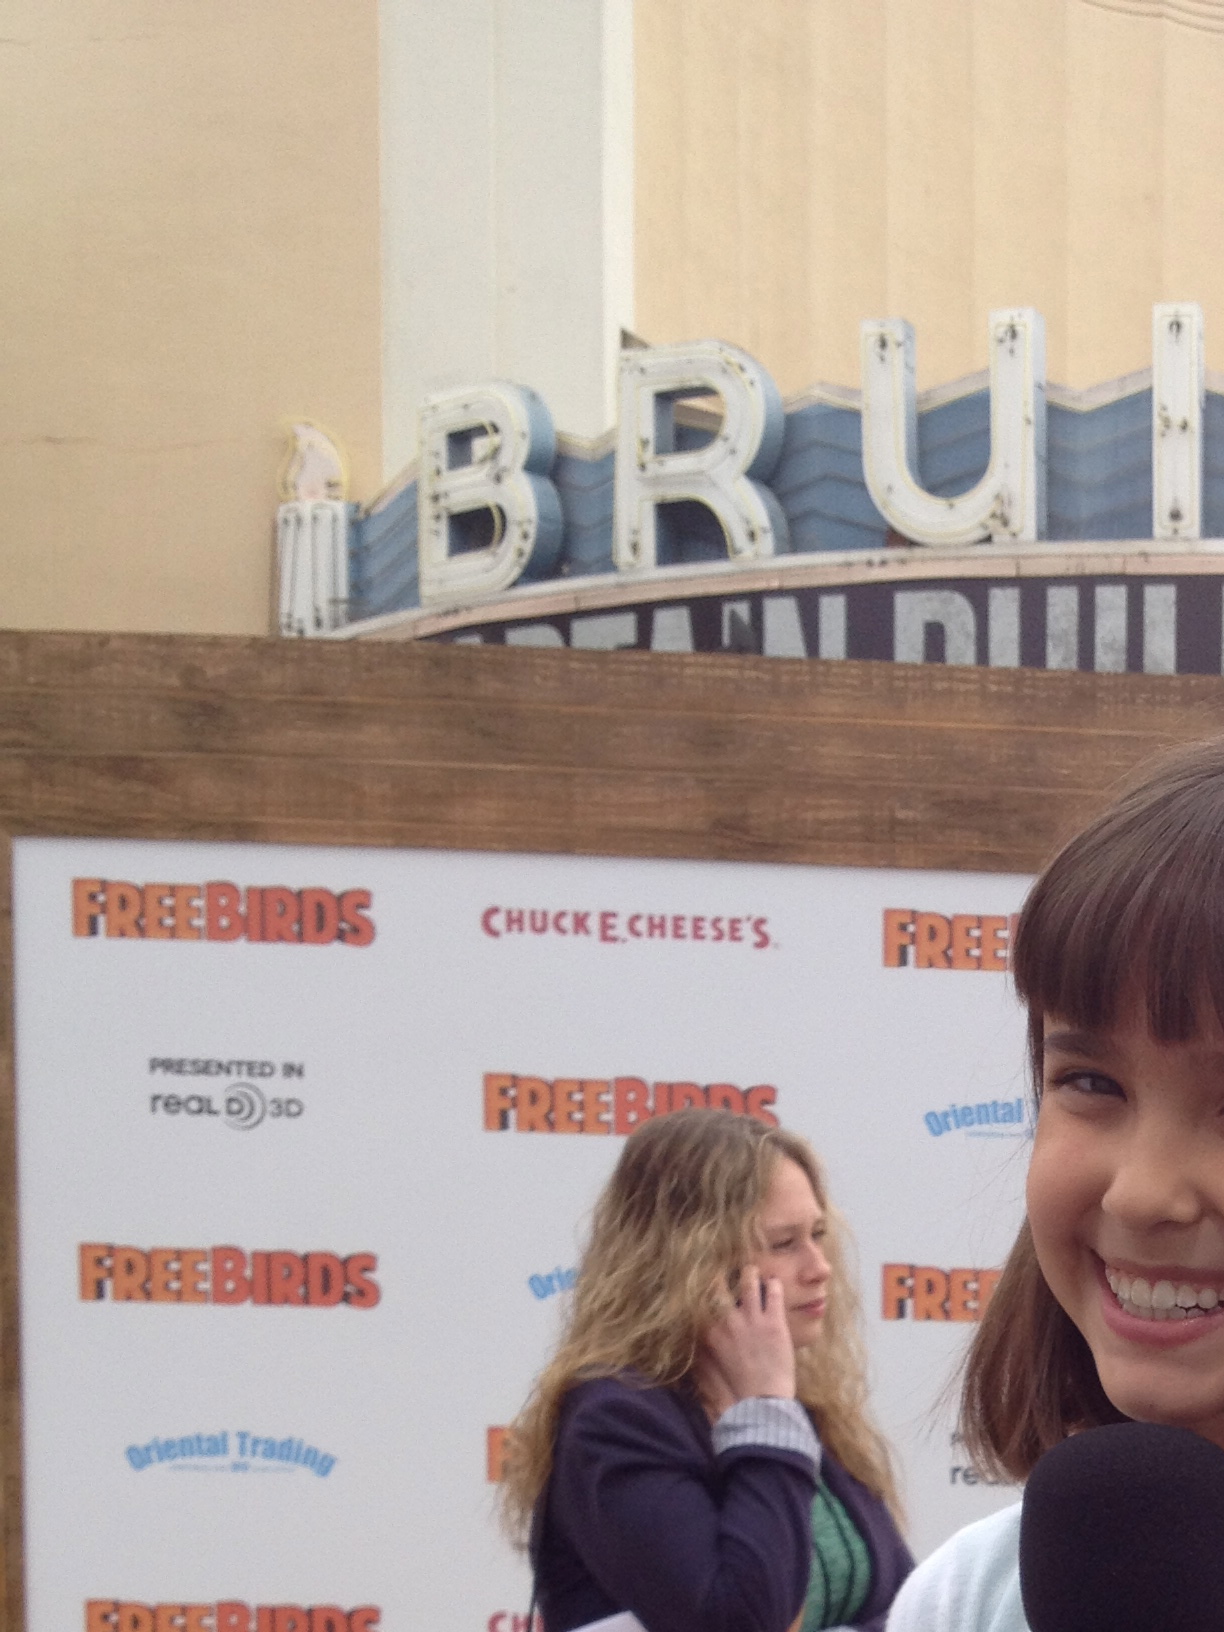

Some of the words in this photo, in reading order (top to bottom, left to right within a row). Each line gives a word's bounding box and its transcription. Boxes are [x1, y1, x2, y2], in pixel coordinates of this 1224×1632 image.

[480, 904, 592, 939] CHUCK
[624, 912, 771, 950] CHEESE'S
[282, 1062, 305, 1079] IN
[924, 1094, 1026, 1138] Oriental
[124, 1431, 229, 1472] Oriental
[234, 1431, 337, 1477] Trading
